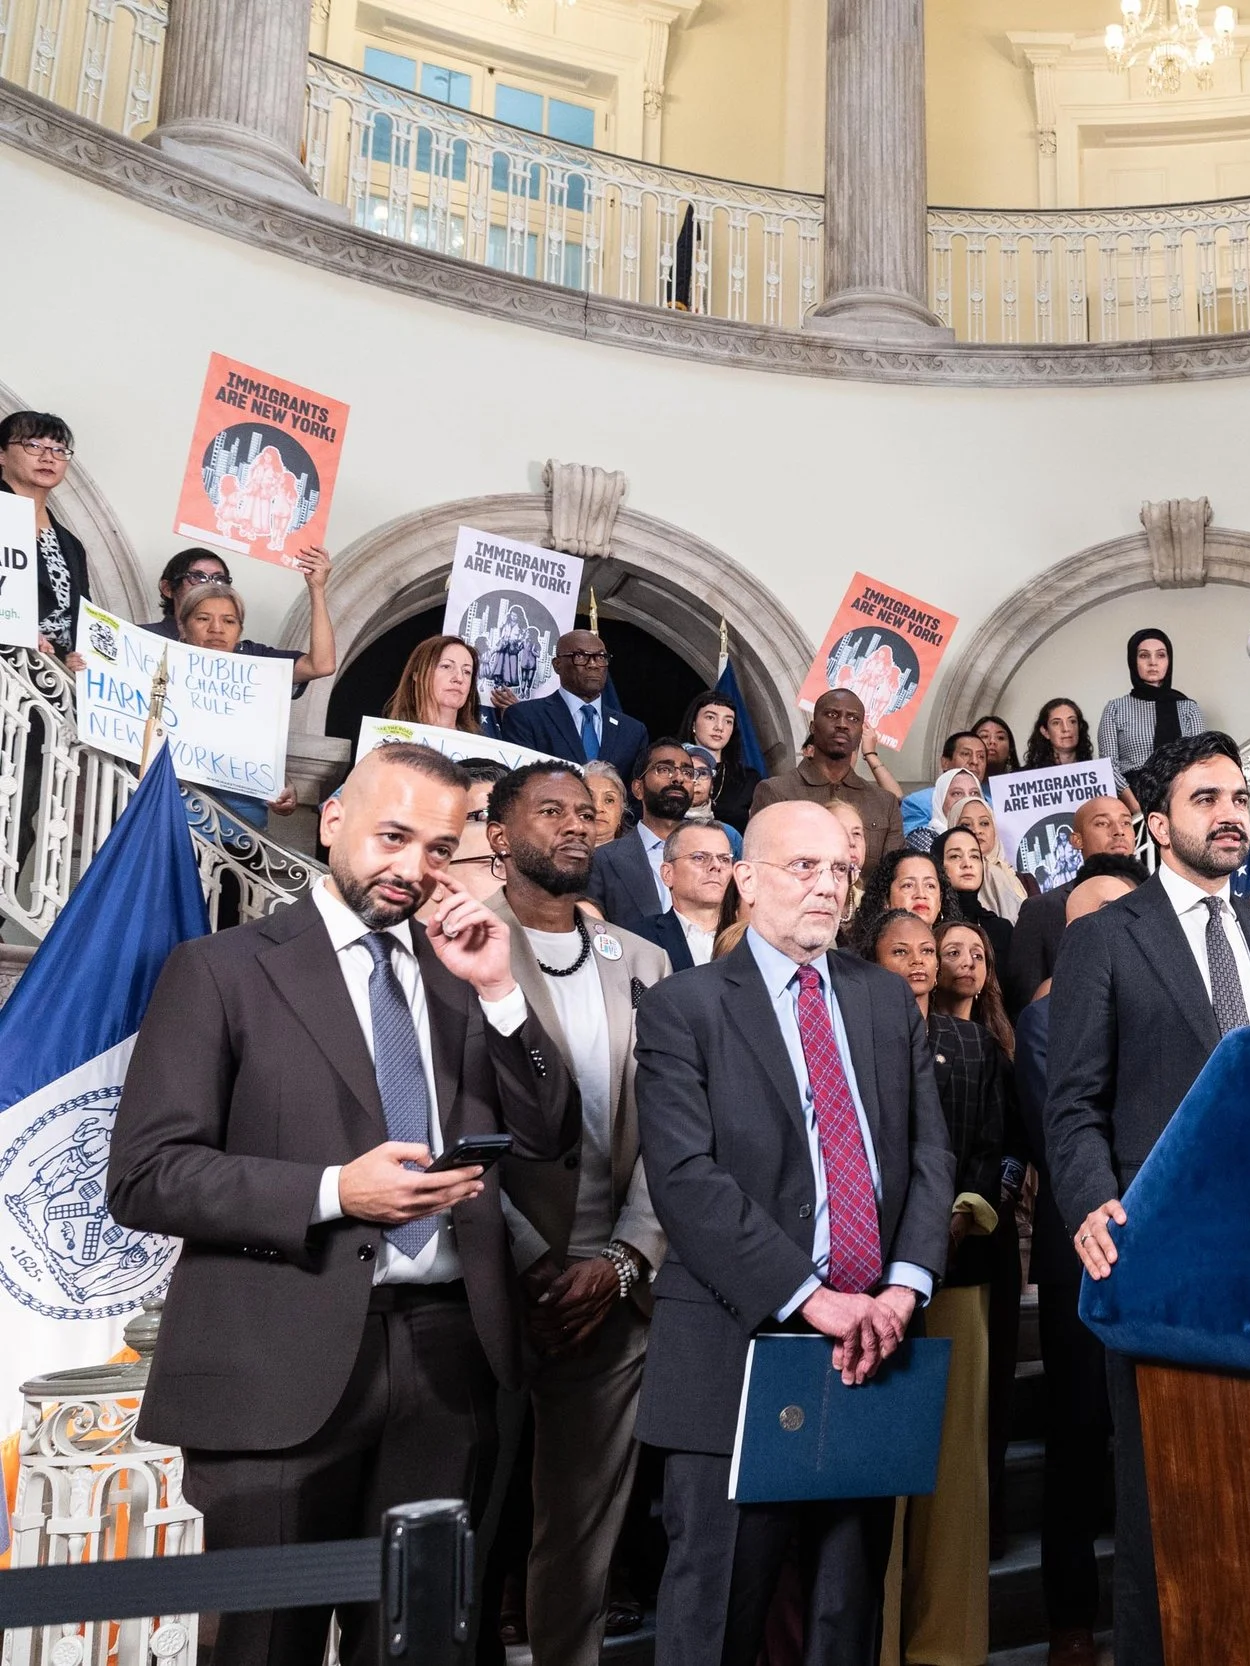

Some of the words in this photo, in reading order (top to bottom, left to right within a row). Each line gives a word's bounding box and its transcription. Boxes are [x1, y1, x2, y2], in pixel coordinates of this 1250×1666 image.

[215, 386, 249, 410] ARE
[251, 399, 287, 423] NEW
[291, 412, 337, 443] YORK!
[226, 371, 330, 423] IMMIGRANTS
[0, 547, 28, 570] ID
[464, 555, 493, 574] ARE
[495, 563, 528, 583] NEW
[531, 571, 572, 595] YORK!
[475, 541, 567, 578] IMMIGRANTS
[851, 597, 877, 617] ARE
[876, 608, 906, 629] NEW
[907, 620, 943, 647] YORK!
[862, 587, 941, 631] IMMIGRANTS
[188, 653, 262, 686] PUBLIC
[185, 675, 256, 704] CHARGE
[191, 694, 235, 716] RULE
[90, 712, 143, 750] NEW
[168, 731, 275, 791] YORKERS
[1003, 796, 1030, 813] ARE
[1033, 791, 1063, 808] NEW
[1066, 784, 1108, 802] YORK!
[1008, 771, 1098, 797] IMMIGRANTS
